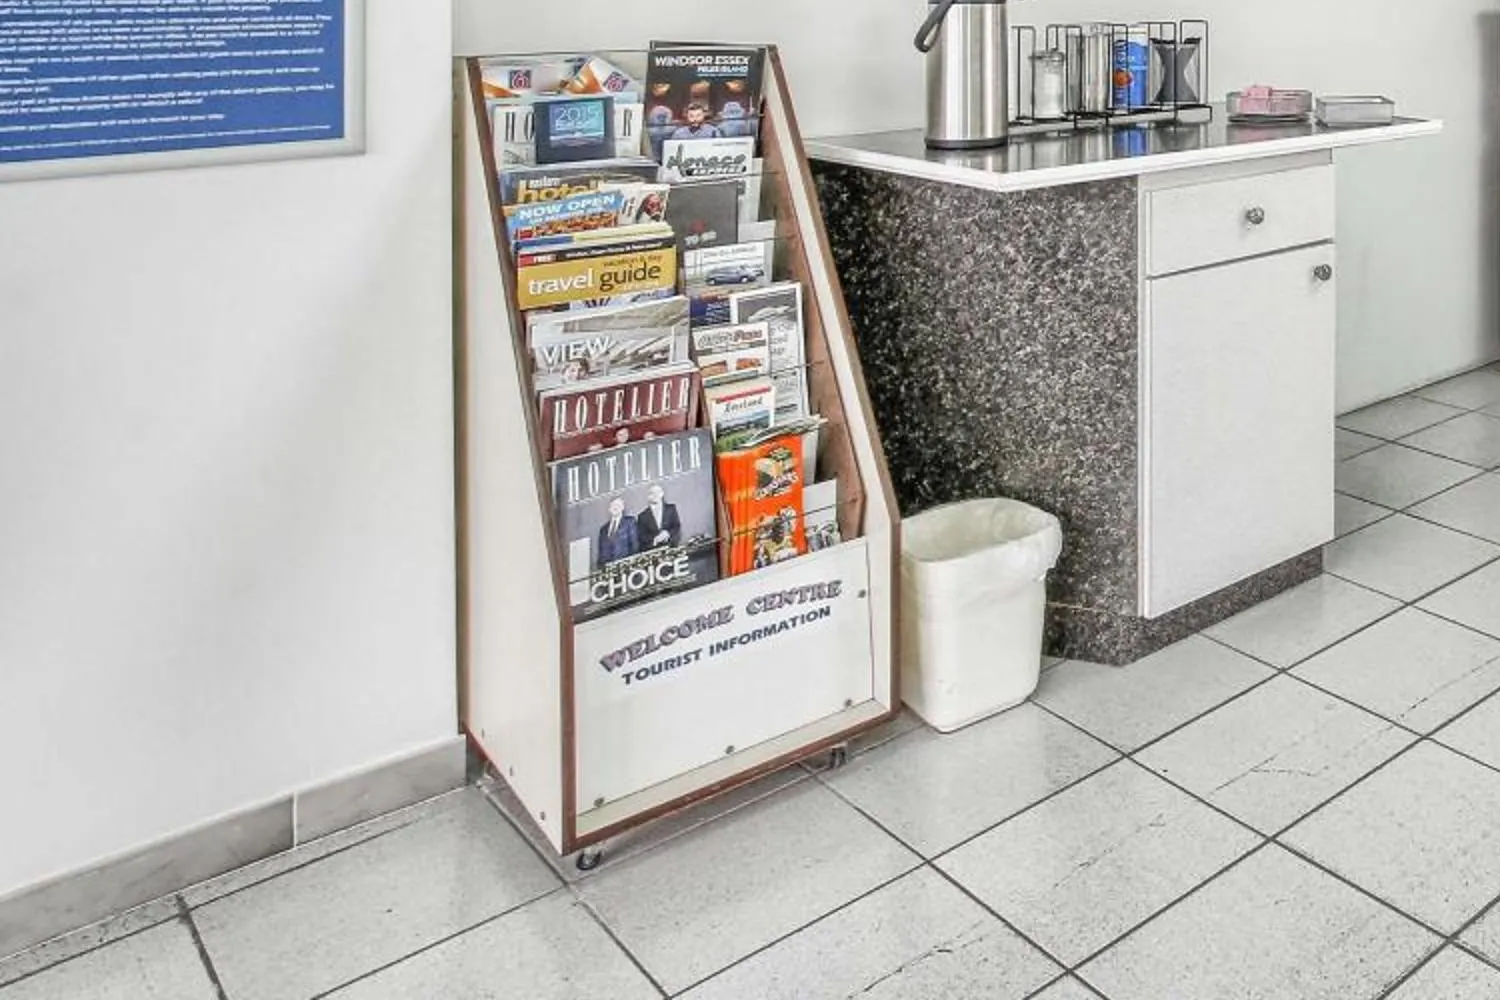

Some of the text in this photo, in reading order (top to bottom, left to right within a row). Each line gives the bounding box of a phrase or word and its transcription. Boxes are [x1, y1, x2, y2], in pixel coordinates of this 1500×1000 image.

[655, 55, 751, 68] WINDSOR ESSEX
[555, 104, 600, 122] 2015
[520, 204, 563, 218] NOW
[567, 194, 616, 211] OPEN
[528, 261, 662, 296] travel guide
[541, 335, 612, 365] VIEW
[554, 378, 690, 434] HOTELIER
[567, 436, 702, 502] HOTELIER
[591, 556, 691, 603] CHOICE
[600, 605, 736, 673] WELCOME
[746, 580, 843, 617] CENTRE
[622, 605, 832, 686] TOURIST INFORMATION
